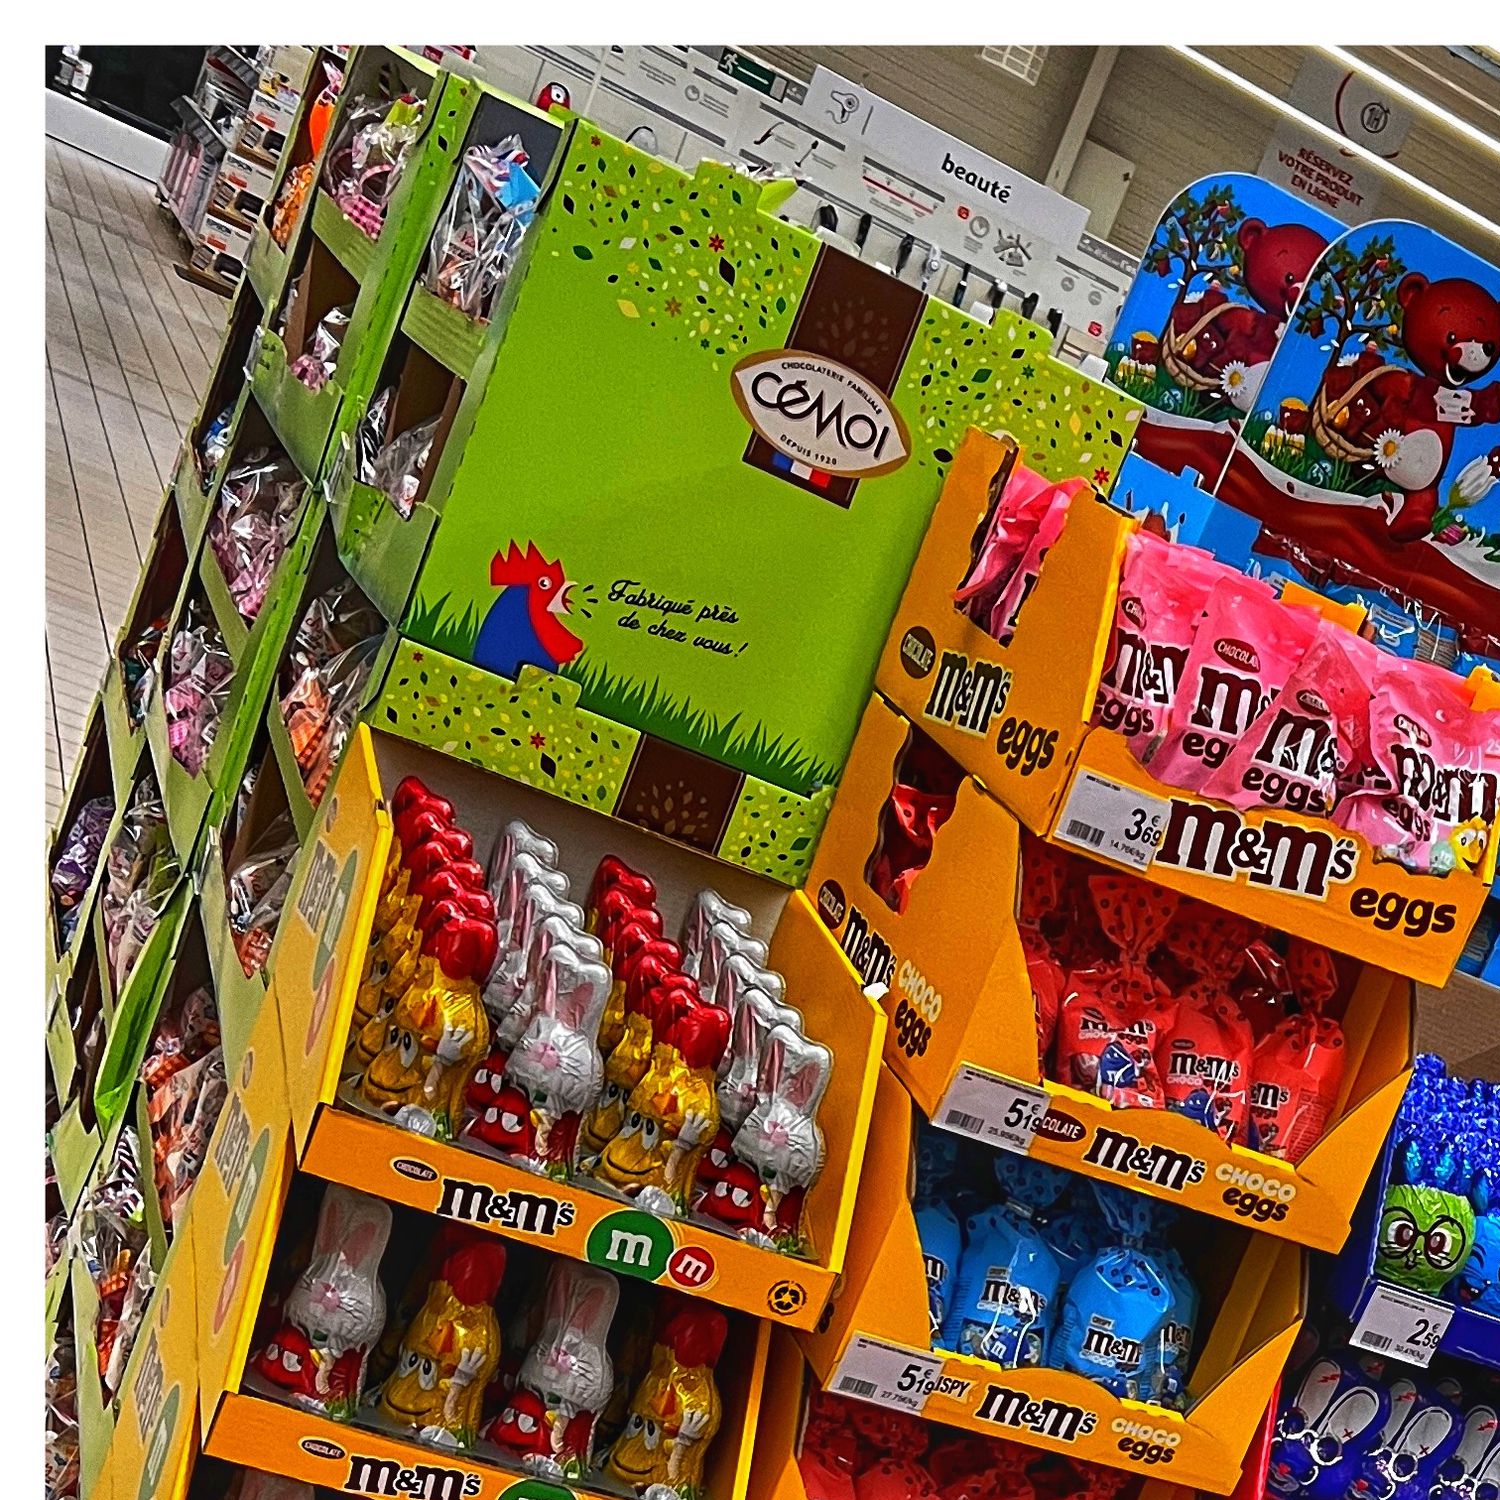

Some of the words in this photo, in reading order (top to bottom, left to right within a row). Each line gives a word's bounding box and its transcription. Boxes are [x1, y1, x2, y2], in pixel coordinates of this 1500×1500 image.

[940, 152, 1011, 203] beauté
[1279, 150, 1316, 179] VOTRE
[1315, 173, 1364, 206] PRODUIT
[1298, 148, 1354, 186] RÉSERVEZ
[1291, 175, 1306, 190] EN
[1307, 183, 1340, 208] LIGNE
[781, 362, 845, 382] CHOCOLATERIE
[780, 434, 811, 457] DEPUIS
[607, 579, 695, 622] Fabriqué
[699, 605, 740, 632] près
[617, 612, 641, 632] de
[644, 616, 690, 645] chez
[996, 717, 1059, 777] eggs
[1242, 767, 1325, 813] eggs
[1382, 800, 1431, 841] eggs
[1350, 886, 1456, 936] eggs
[898, 961, 942, 1023] CHOCO
[894, 1001, 932, 1057] eggs
[1041, 1116, 1081, 1139] COLATE
[396, 1163, 435, 1178] CHOCOLATE
[1215, 1163, 1296, 1201] CHOCO
[1221, 1186, 1289, 1225] eggs
[606, 1229, 653, 1268] m
[676, 1252, 707, 1283] m
[1112, 1418, 1181, 1446] CHOCO
[1117, 1434, 1175, 1464] eggs
